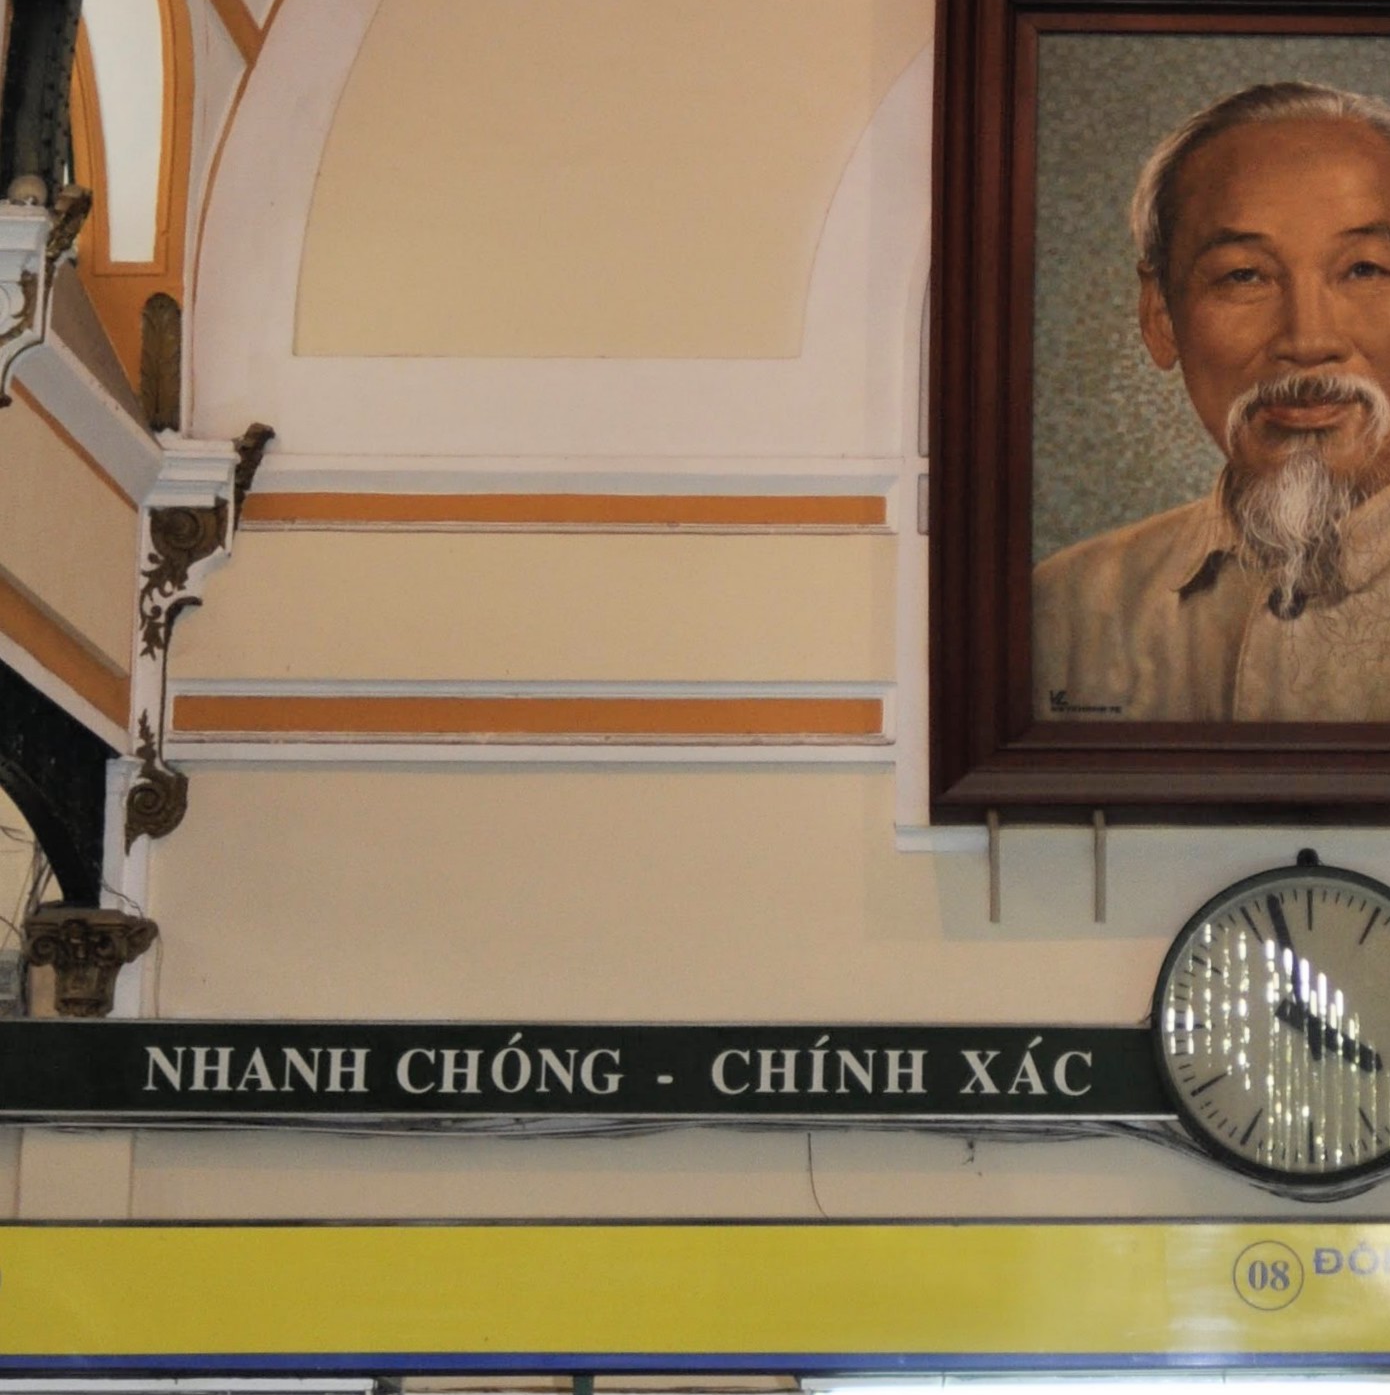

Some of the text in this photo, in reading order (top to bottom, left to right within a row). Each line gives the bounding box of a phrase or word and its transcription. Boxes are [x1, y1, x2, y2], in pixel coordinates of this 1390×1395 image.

[144, 1046, 370, 1093] NHANH
[396, 1032, 624, 1095] CHÓNG
[711, 1034, 927, 1095] CHÍNH
[960, 1035, 1093, 1096] XÁC
[1247, 1259, 1291, 1292] 08
